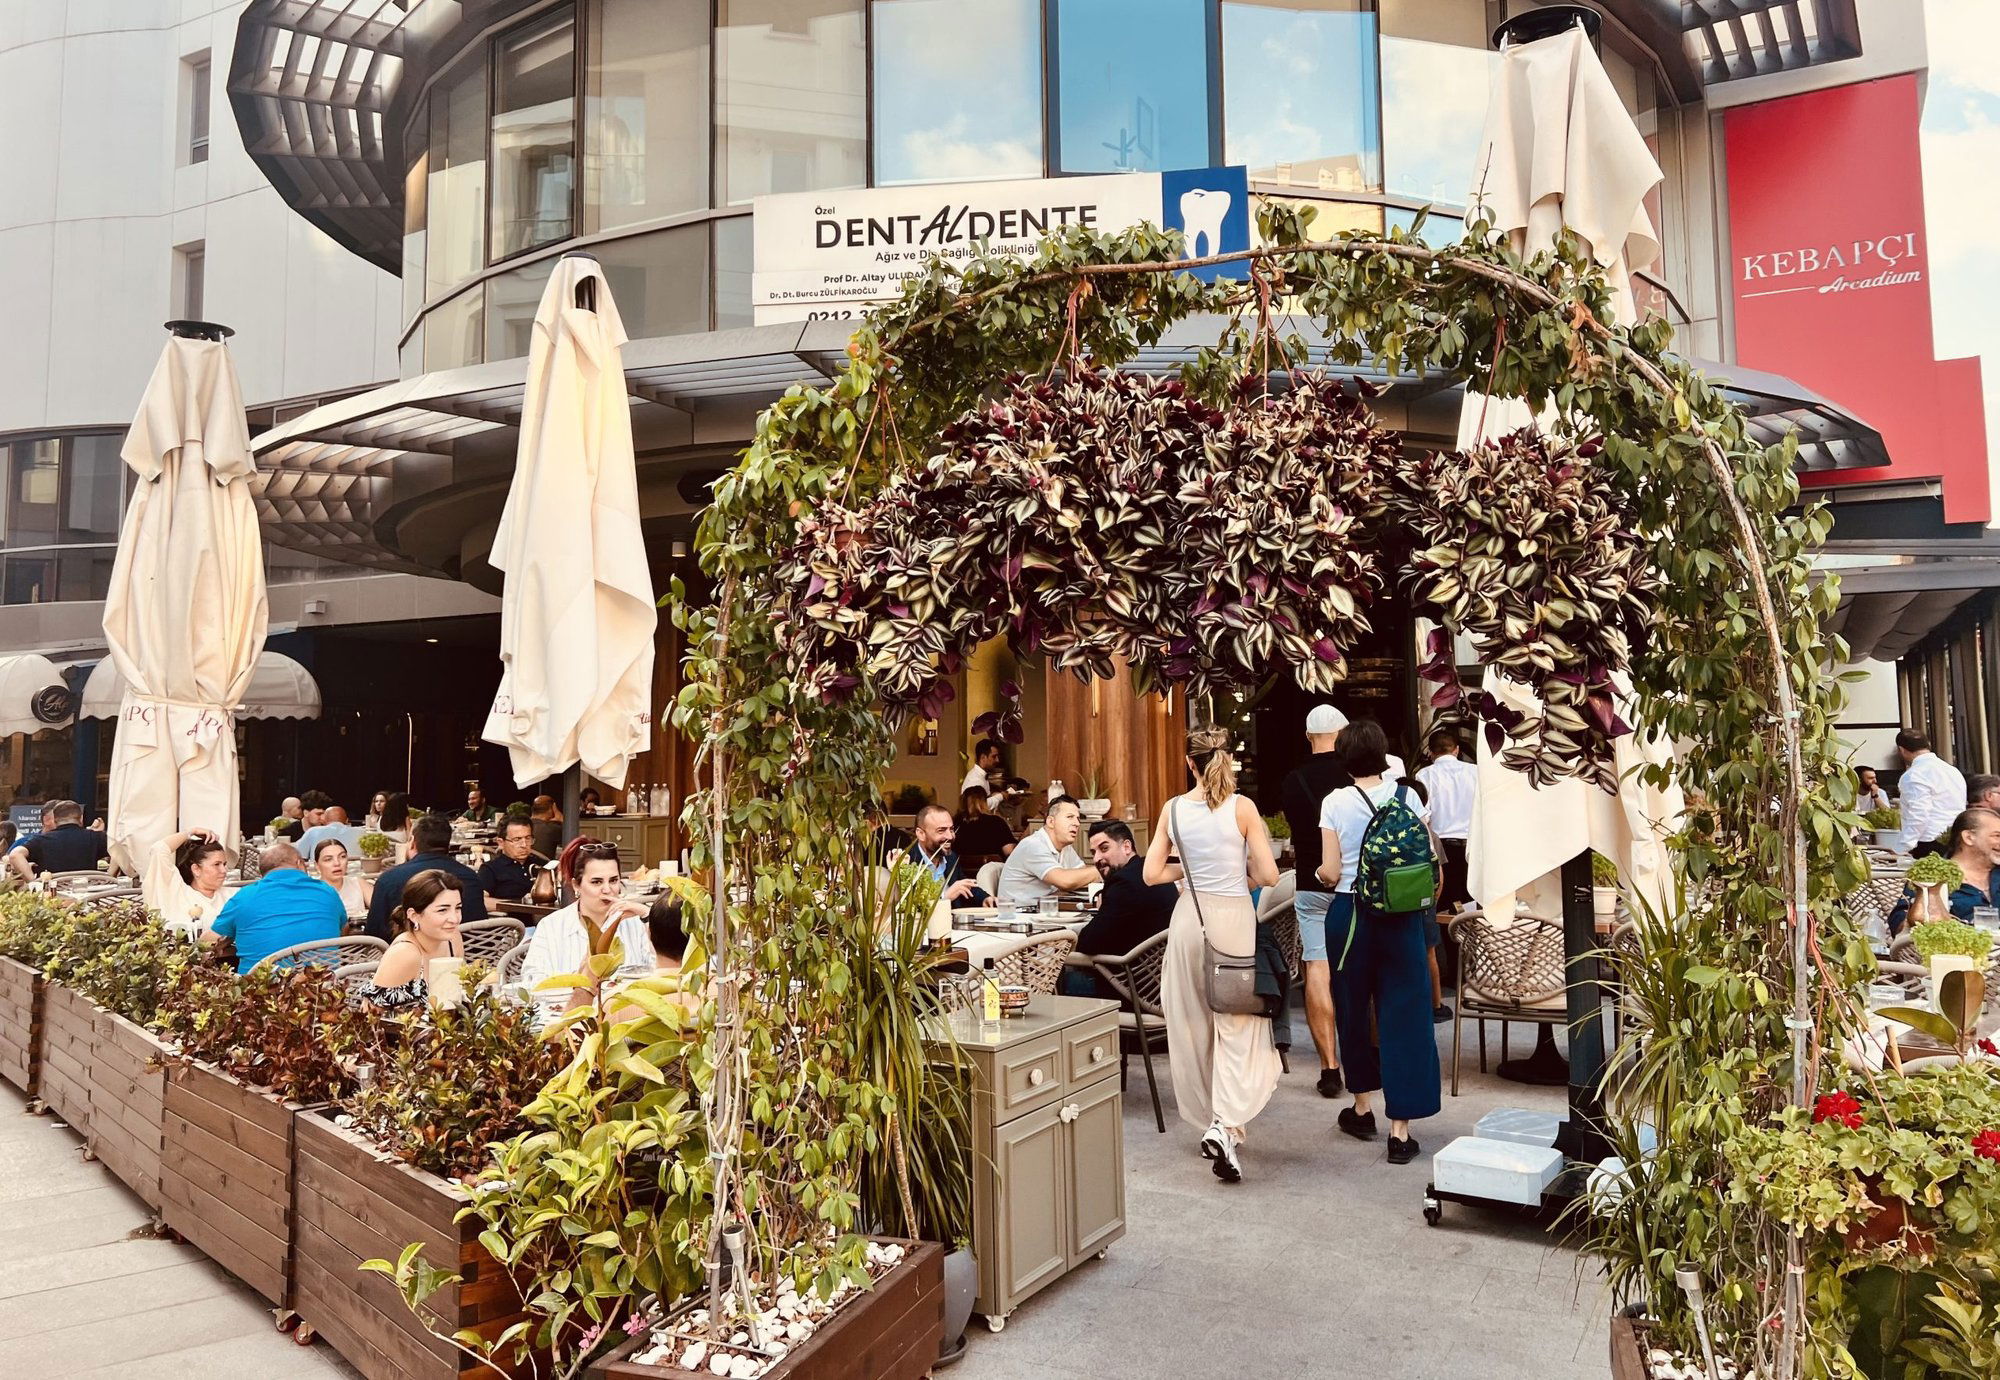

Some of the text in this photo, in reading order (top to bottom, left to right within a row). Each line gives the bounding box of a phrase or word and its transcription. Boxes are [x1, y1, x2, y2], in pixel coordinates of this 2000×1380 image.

[815, 205, 835, 215] Özel
[876, 252, 900, 263] Ağız
[903, 252, 916, 260] ve
[1741, 233, 1917, 281] KEBAPÇI
[824, 275, 843, 284] Prof
[845, 274, 859, 282] Dr.
[861, 273, 886, 283] Altay
[1818, 270, 1921, 294] Arcadium
[796, 290, 819, 298] Burcu
[820, 287, 878, 297] ZÜLFİKAROĞLU
